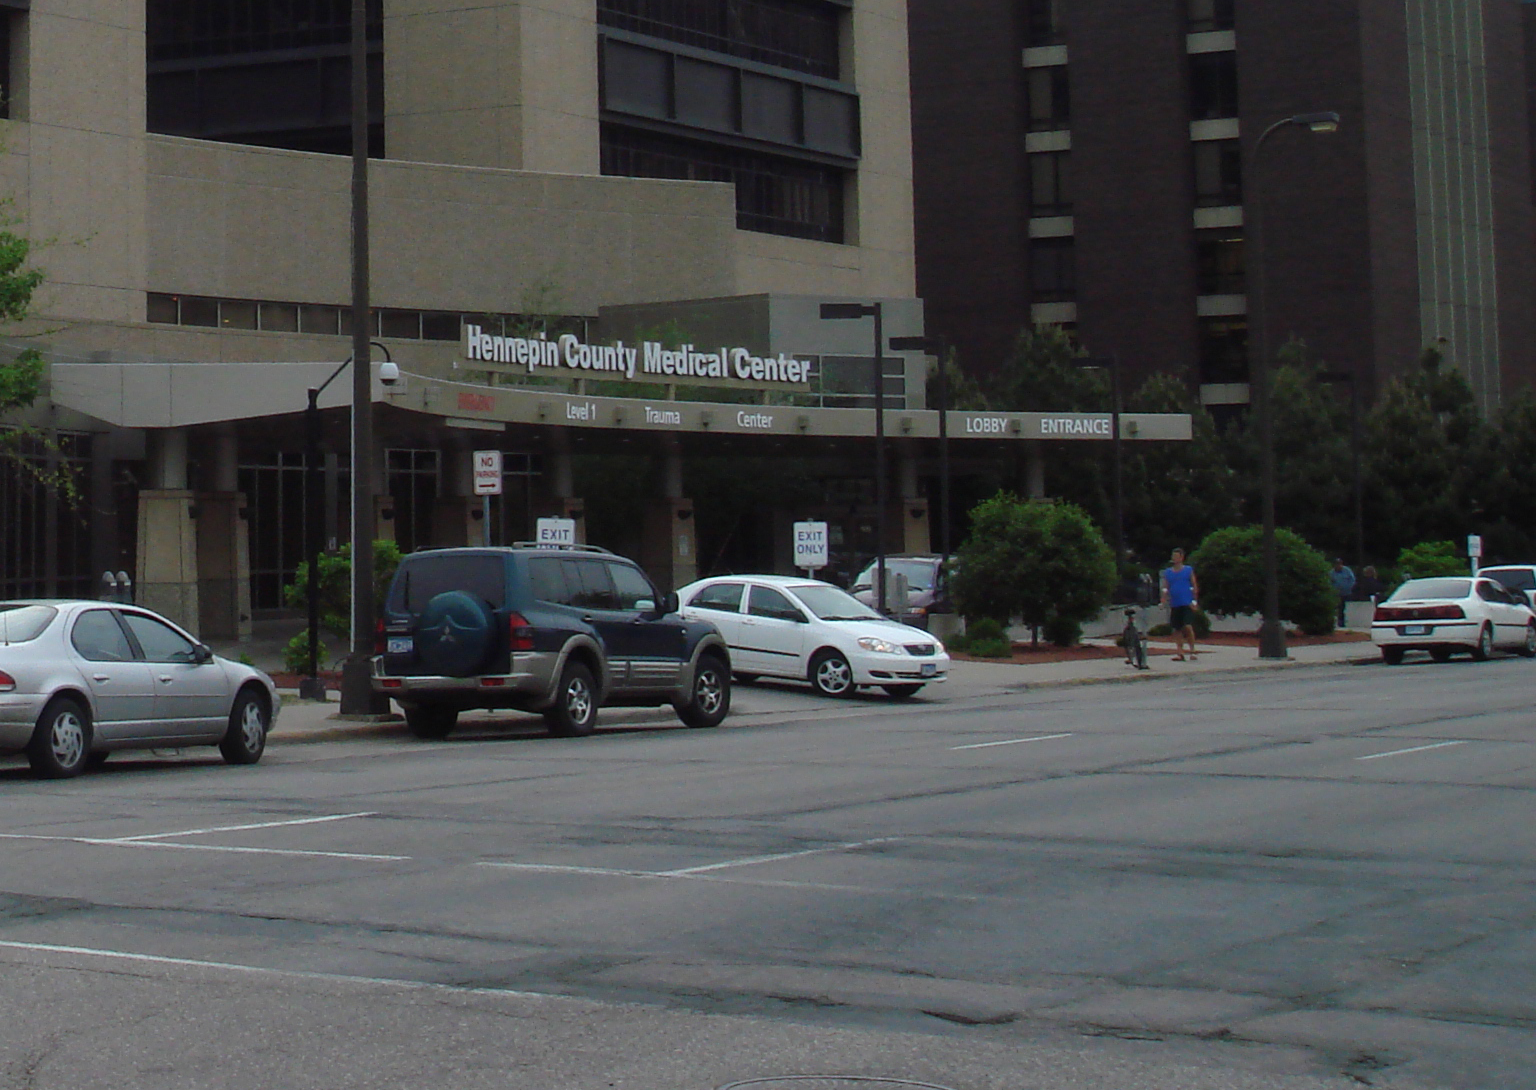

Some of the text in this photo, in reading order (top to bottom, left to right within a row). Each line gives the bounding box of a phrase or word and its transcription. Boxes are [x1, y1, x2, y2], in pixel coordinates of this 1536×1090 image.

[466, 324, 811, 383] Hennepin County Medical Center
[566, 401, 773, 428] Level 1 Trauma Center
[966, 417, 1110, 434] LOBBY ENTRANCE
[480, 456, 494, 467] NO
[541, 528, 570, 540] EXIT
[797, 531, 822, 541] EXIT
[797, 544, 824, 554] ONLY
